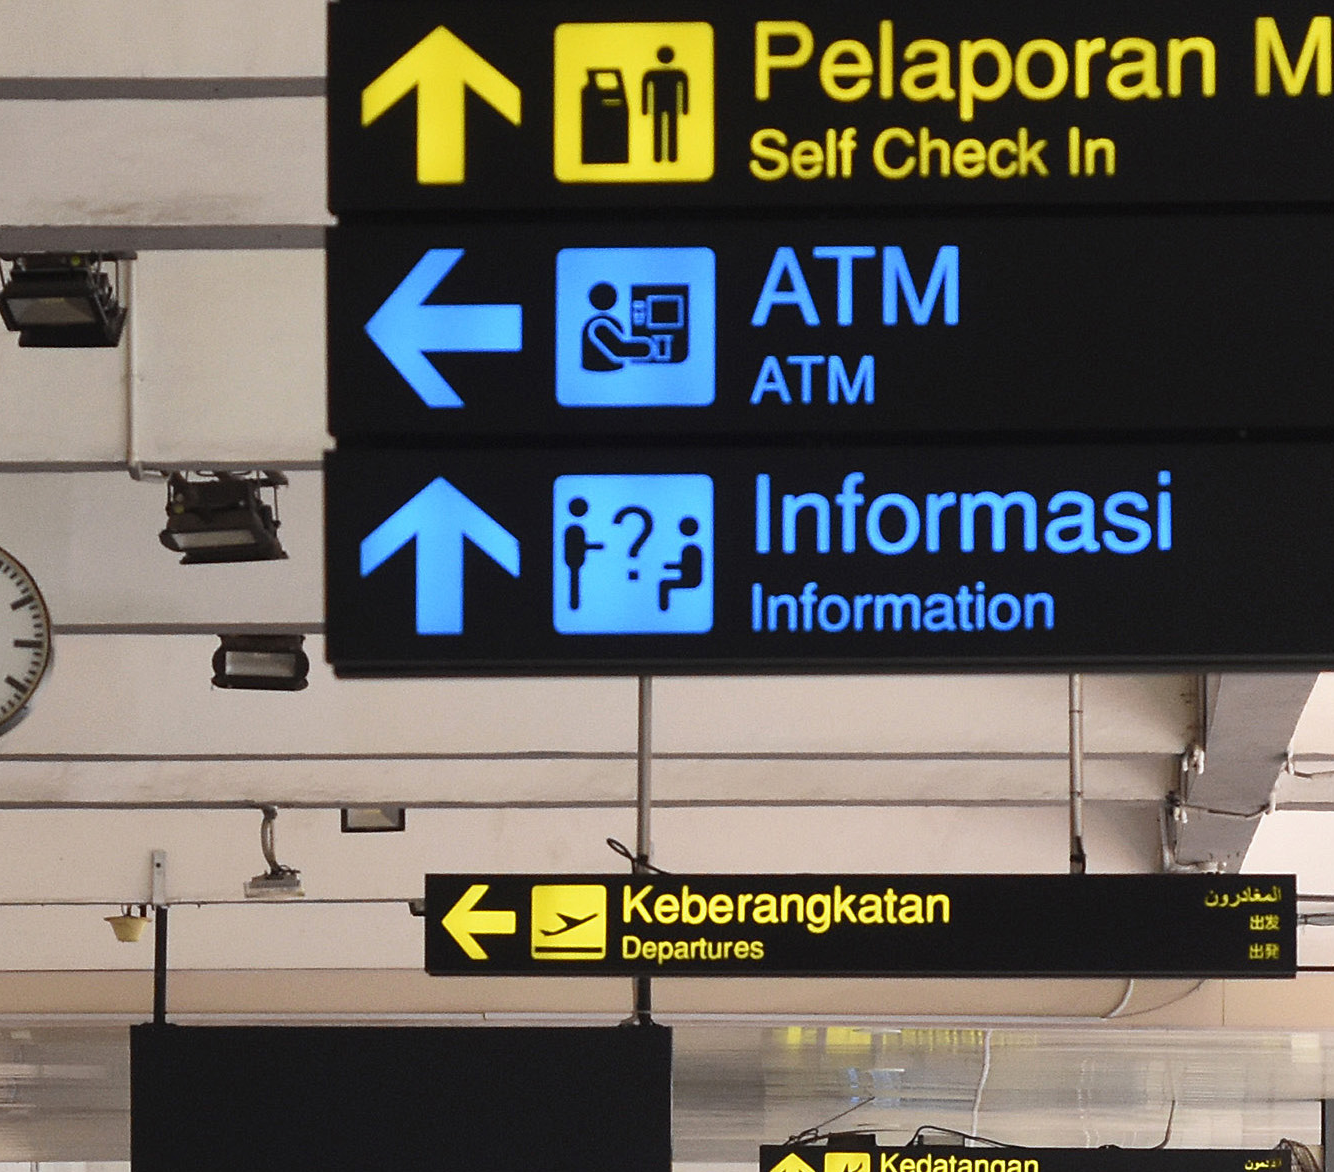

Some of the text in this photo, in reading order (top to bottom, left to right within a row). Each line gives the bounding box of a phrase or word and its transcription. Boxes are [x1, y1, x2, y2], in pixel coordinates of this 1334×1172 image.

[754, 20, 1217, 122] Pelaporan
[749, 126, 1116, 181] Self Check In
[750, 245, 960, 328] ATM
[749, 355, 876, 405] ATM
[755, 470, 1173, 556] Informasi
[751, 580, 1055, 633] Information
[622, 885, 950, 927] Keberangkatan
[1205, 885, 1281, 908] المغادرون
[1249, 914, 1279, 931] 出发
[621, 935, 765, 965] Departures
[1249, 943, 1279, 960] 出発
